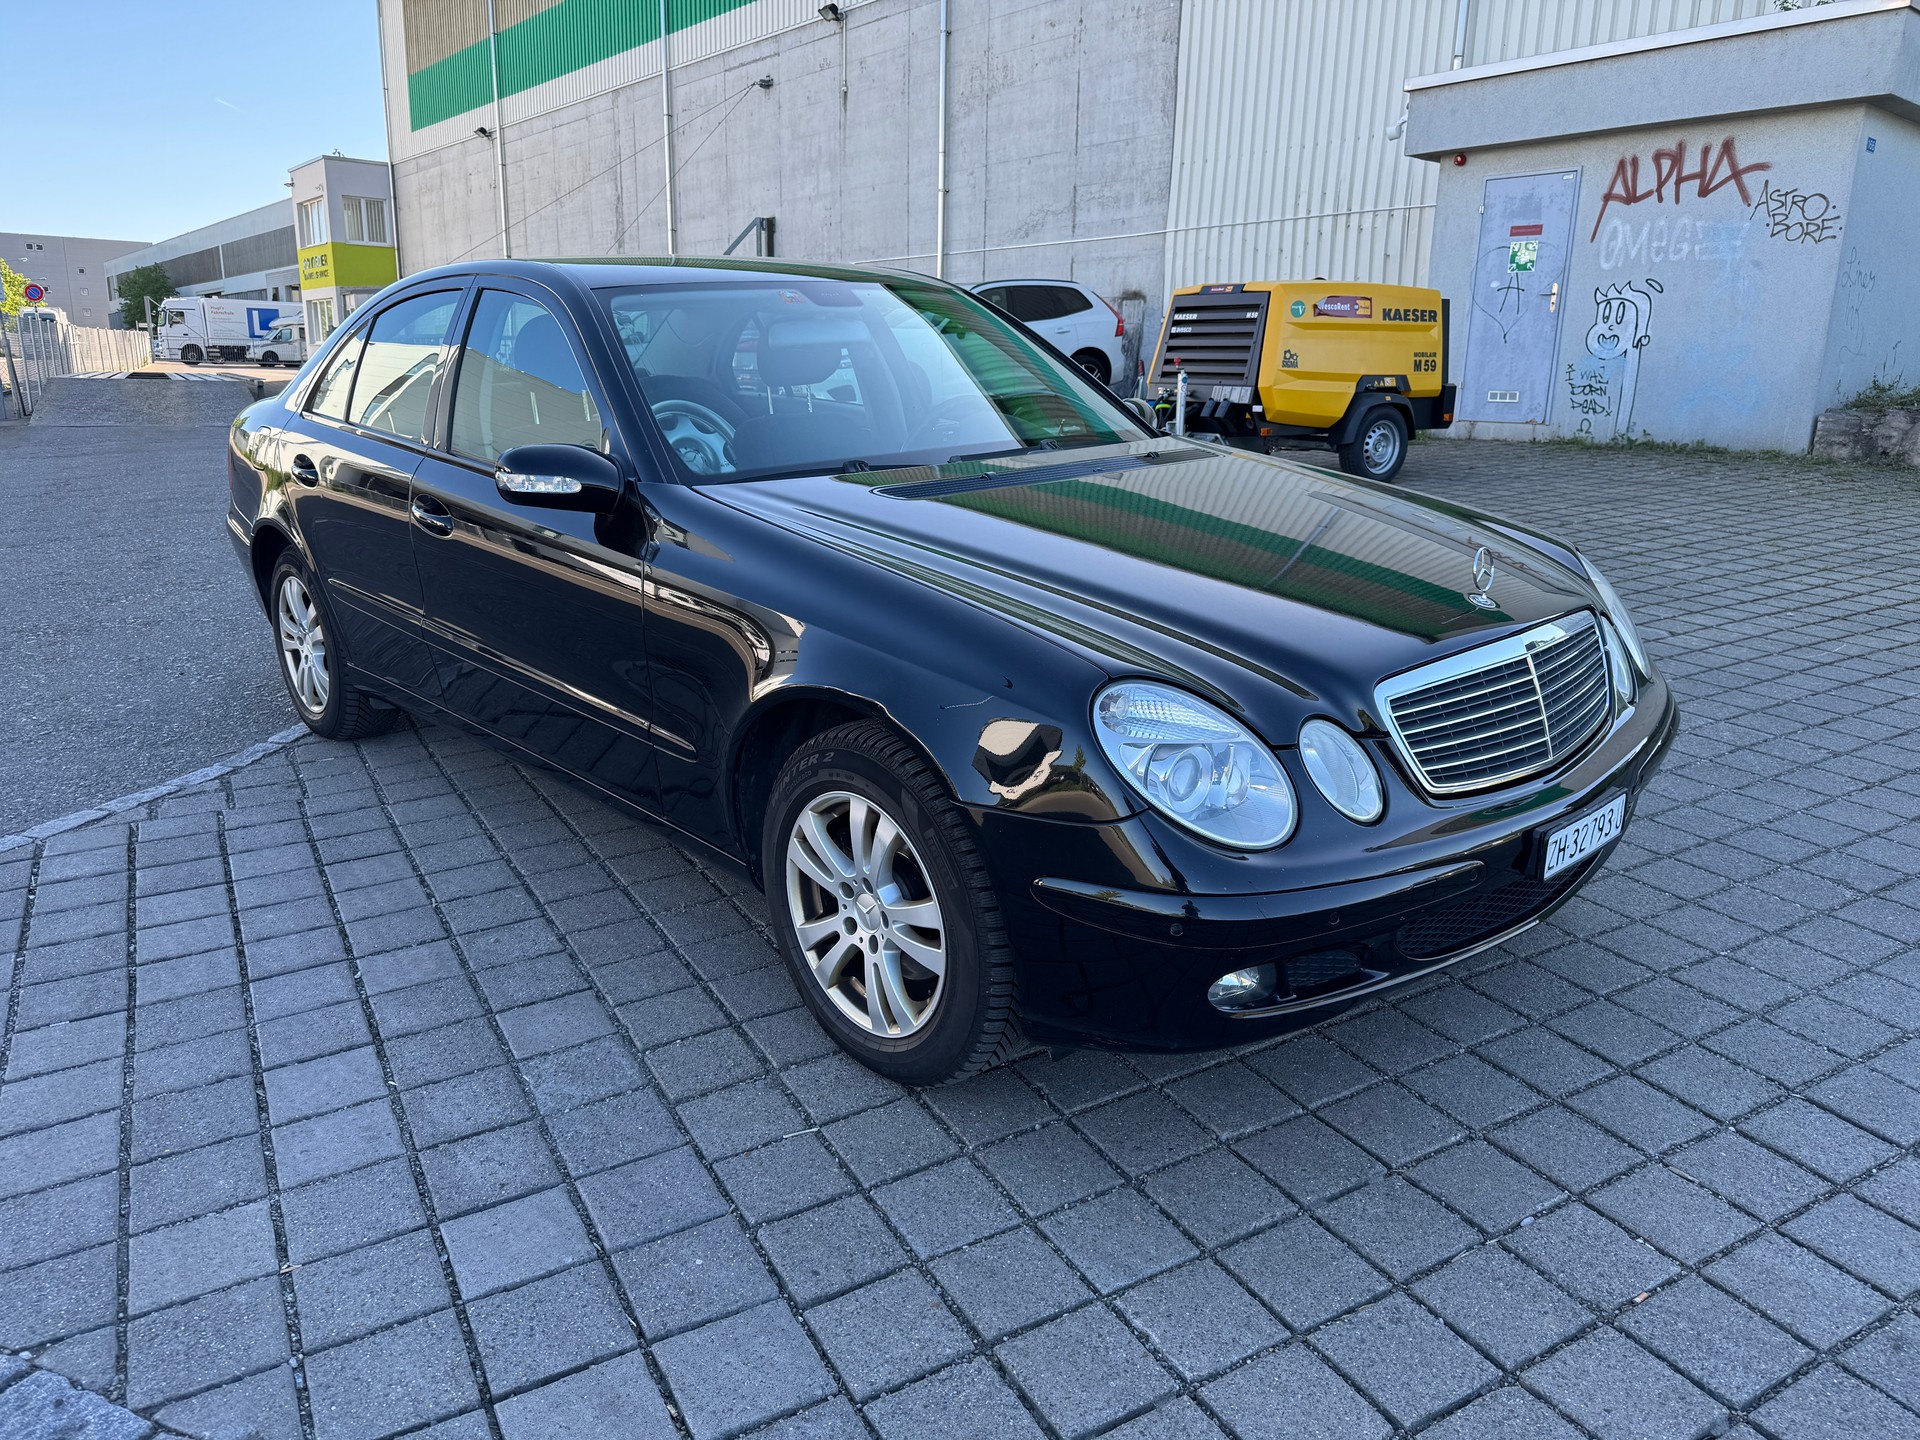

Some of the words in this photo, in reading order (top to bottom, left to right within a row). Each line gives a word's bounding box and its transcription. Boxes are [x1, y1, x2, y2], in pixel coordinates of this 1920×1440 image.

[1591, 137, 1773, 243] ALPHA
[1382, 308, 1438, 322] KAESER
[1281, 359, 1299, 369] SIGMA
[1568, 382, 1607, 397] BORN
[771, 753, 820, 808] WINTER
[822, 751, 835, 762] 2
